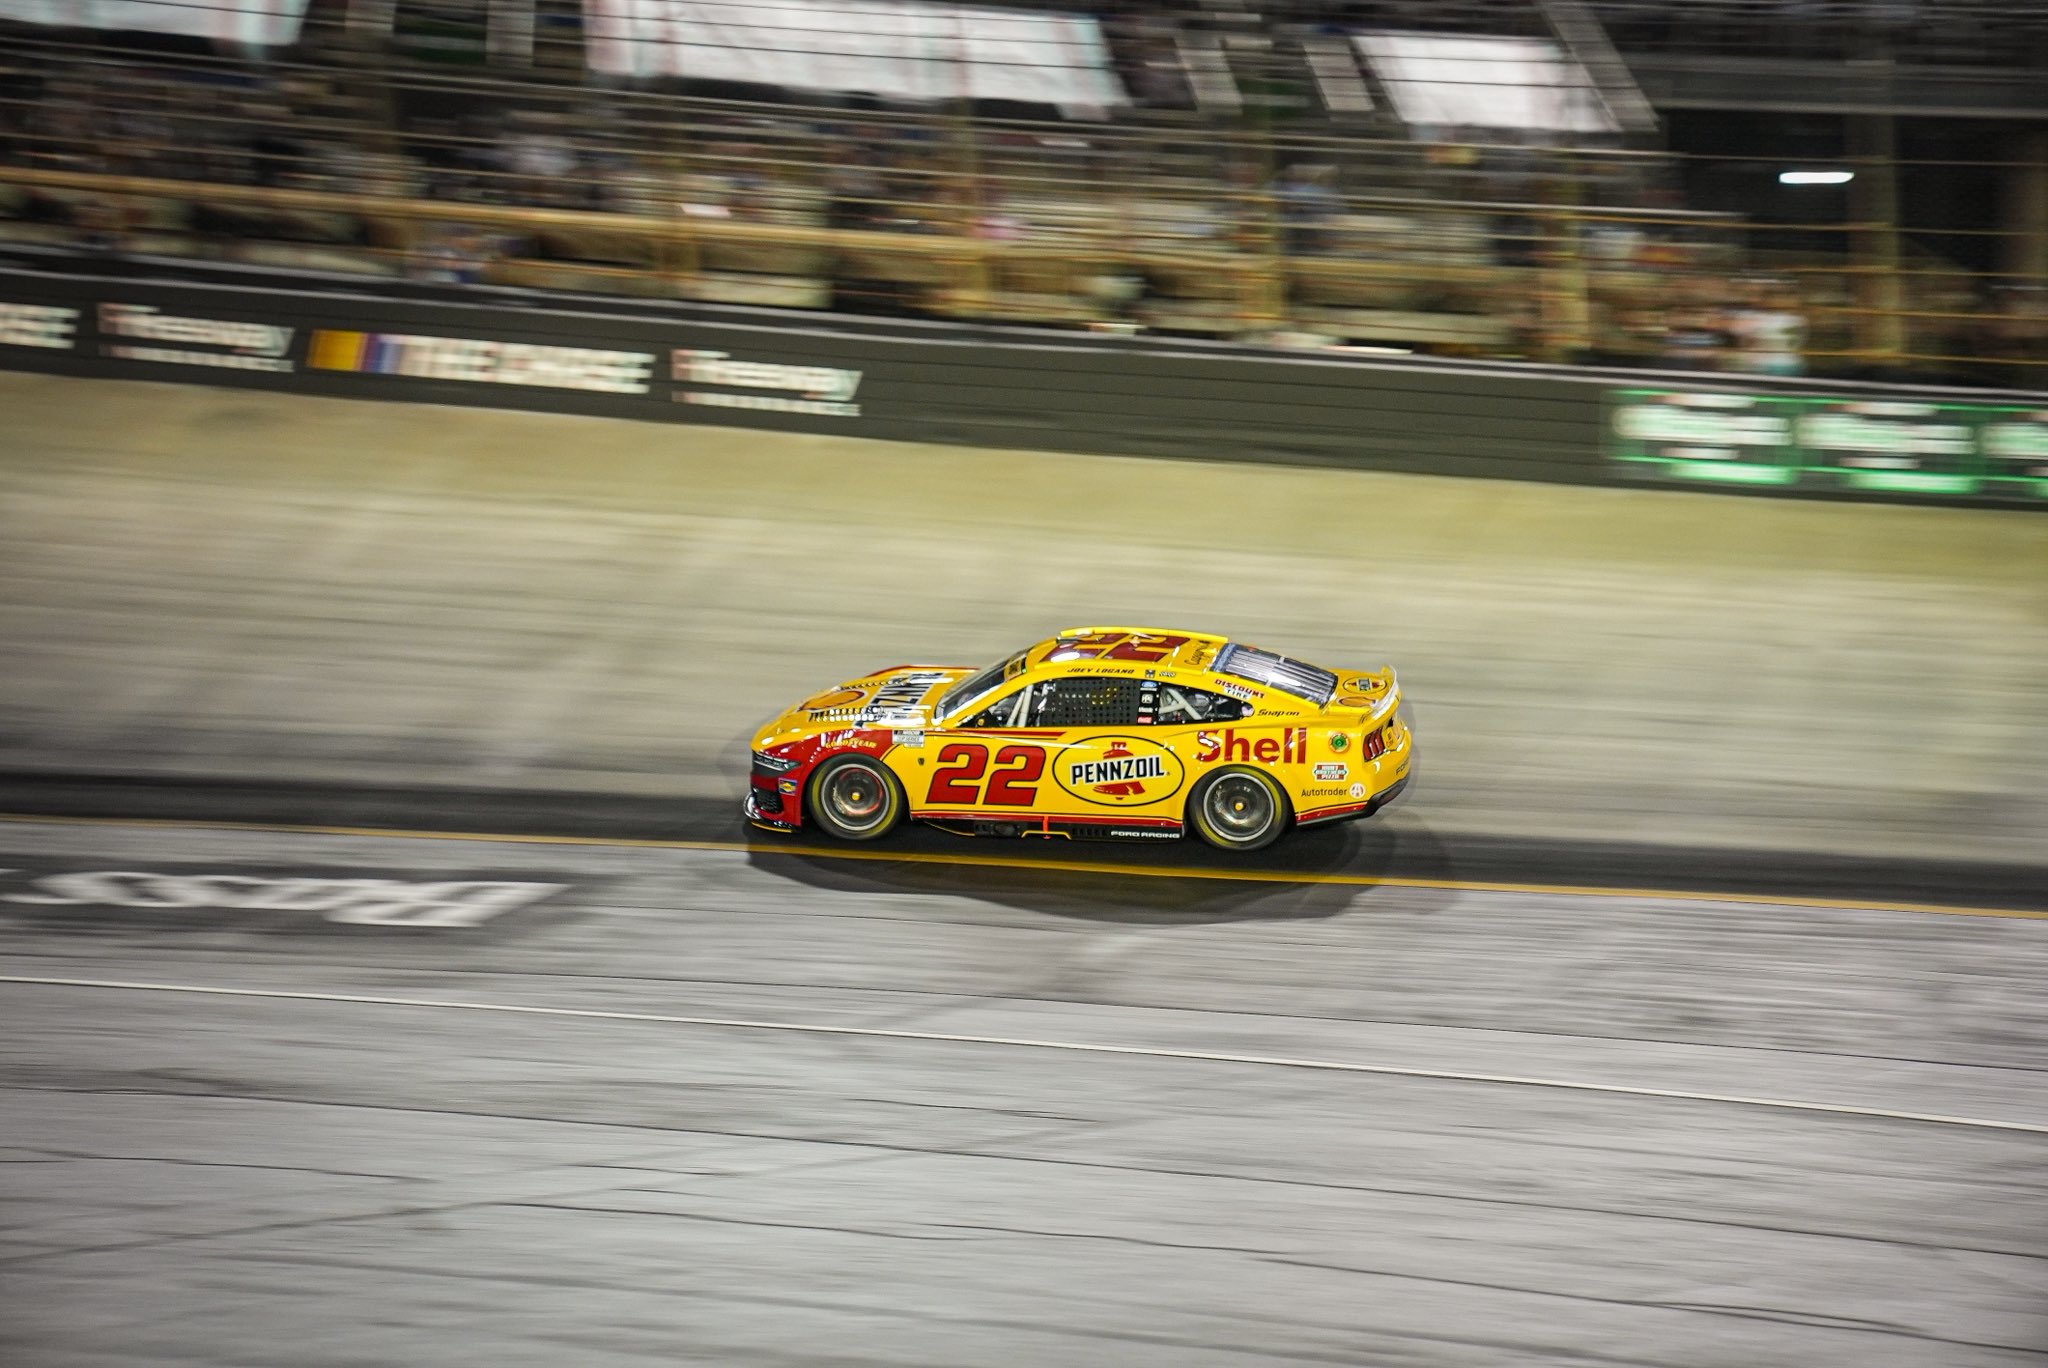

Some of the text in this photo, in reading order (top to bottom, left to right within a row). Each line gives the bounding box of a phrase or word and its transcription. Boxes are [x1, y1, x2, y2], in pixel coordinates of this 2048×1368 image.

[1214, 679, 1265, 699] DISCOUNT
[1226, 687, 1248, 699] TIRE
[1196, 727, 1307, 764] Shell
[925, 743, 1046, 807] 22
[1071, 756, 1165, 785] PENNZOIL
[1301, 787, 1347, 797] Autotrader
